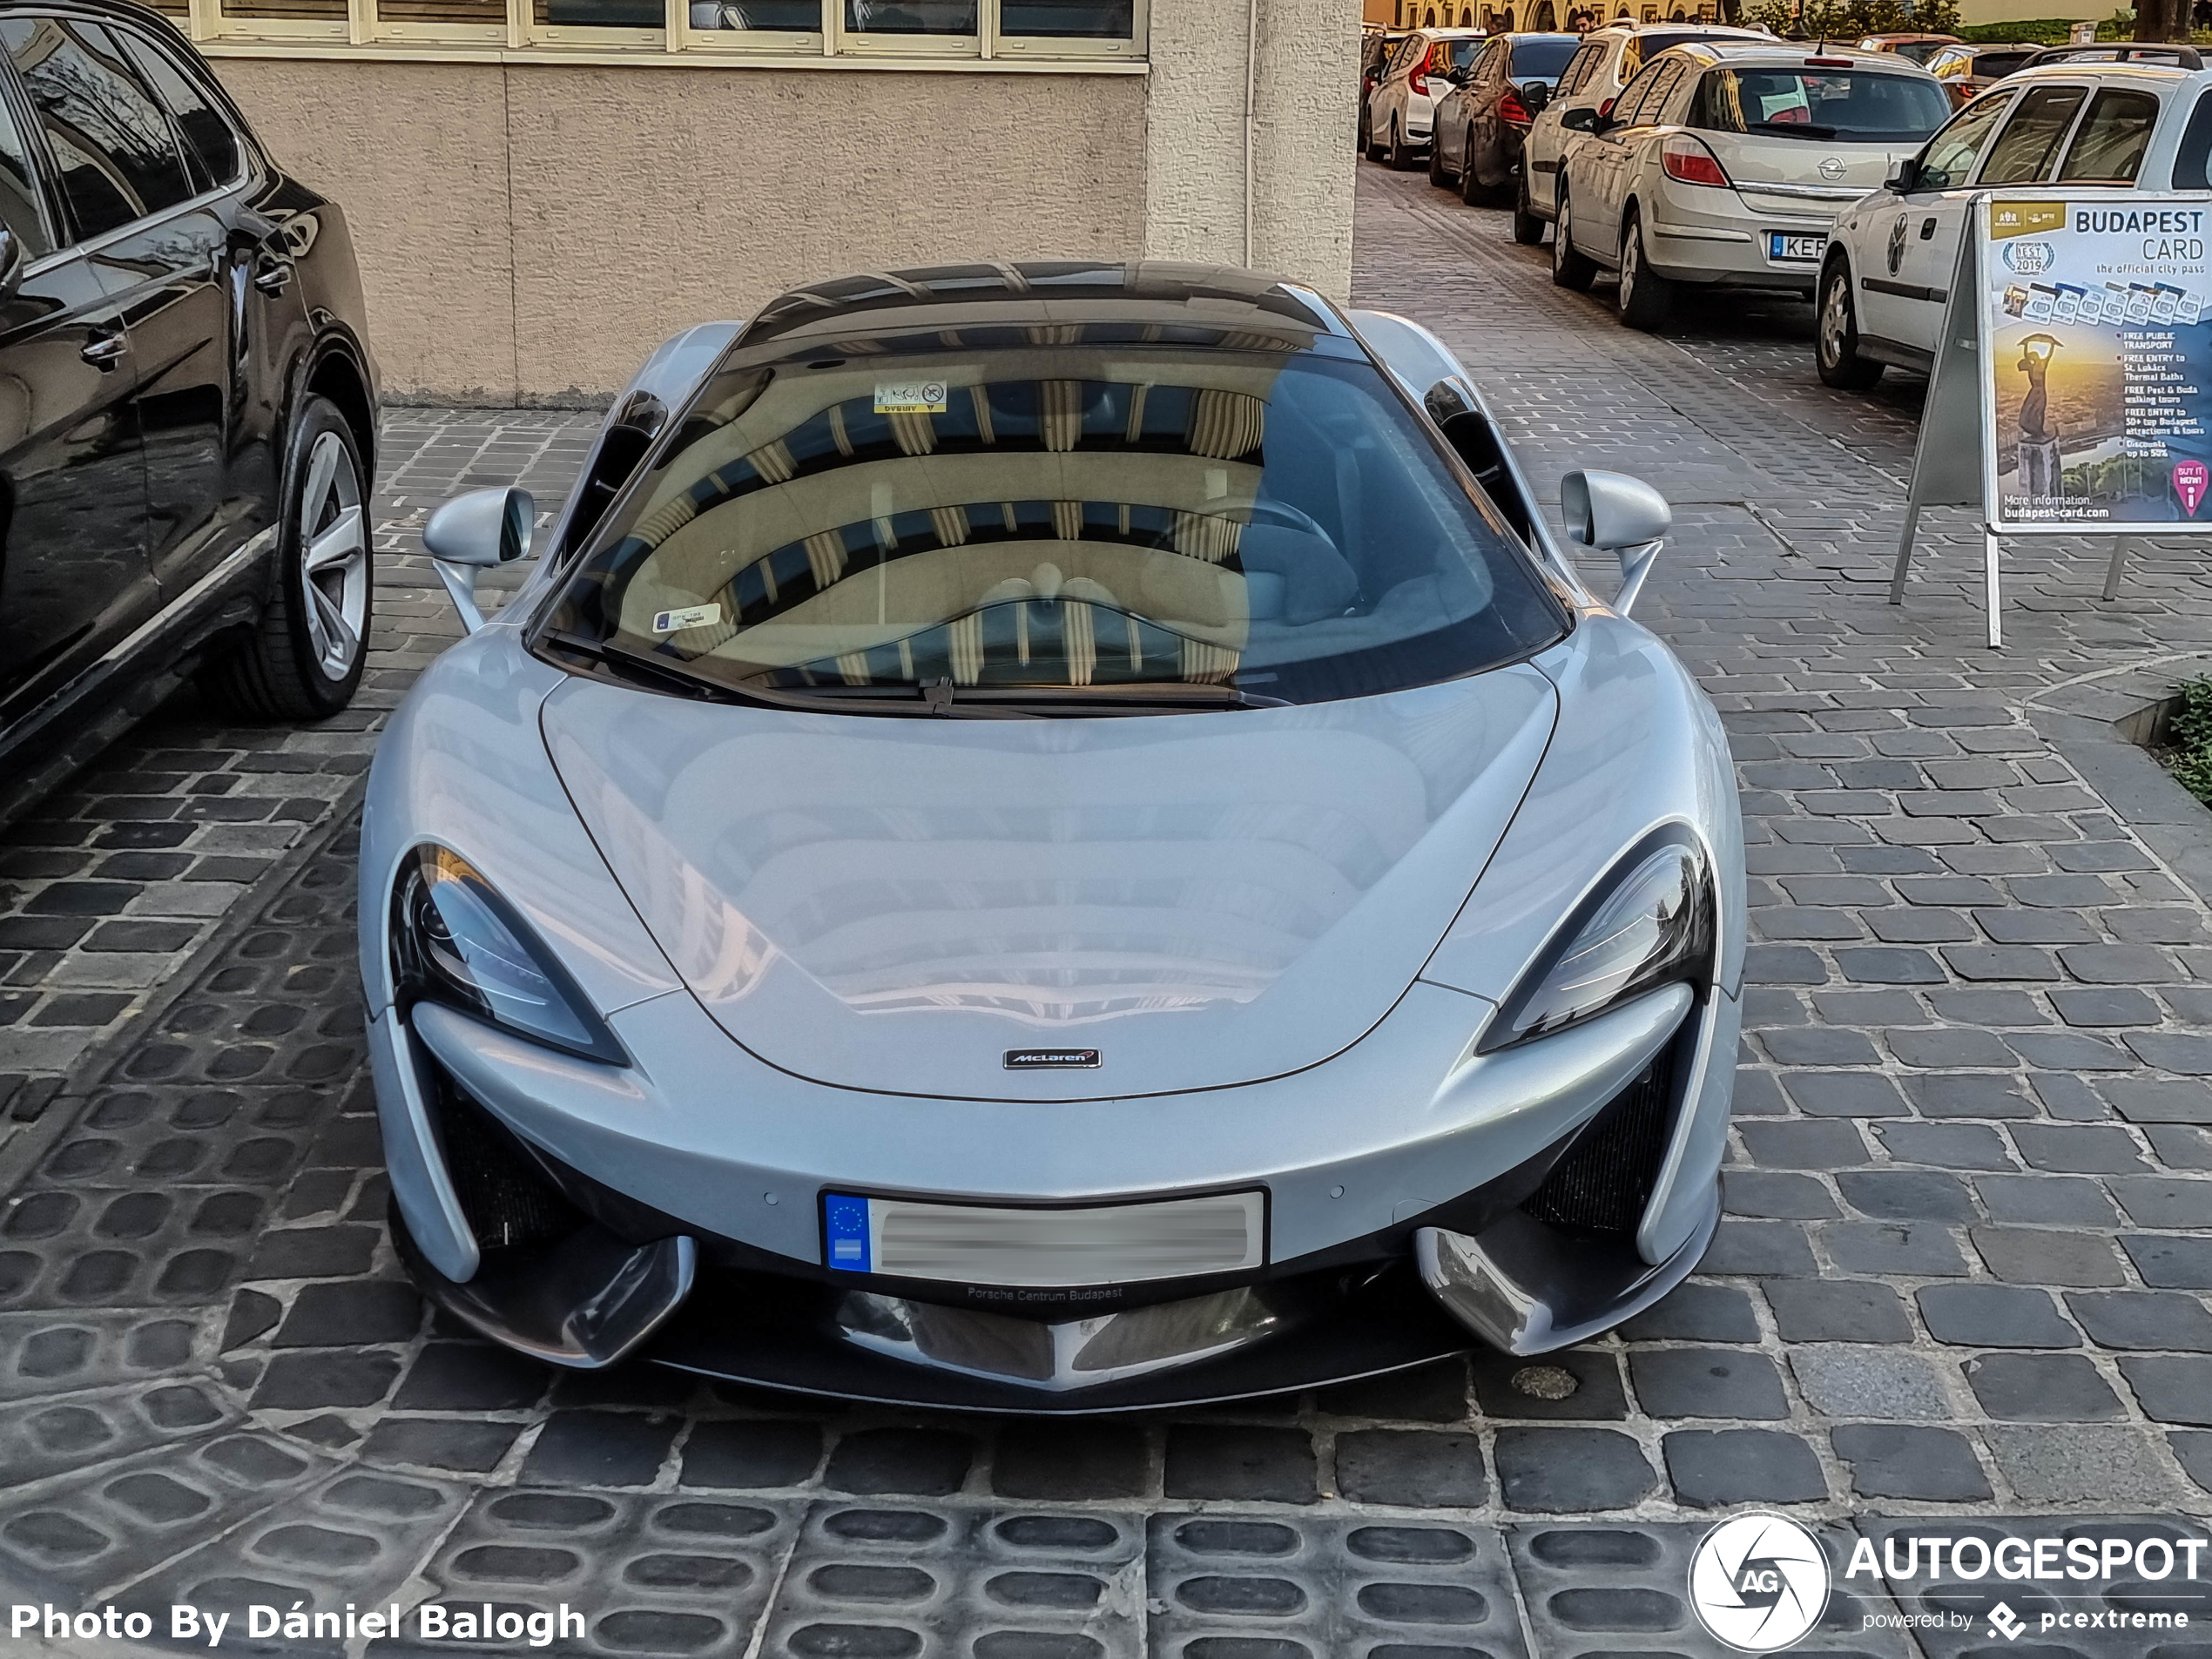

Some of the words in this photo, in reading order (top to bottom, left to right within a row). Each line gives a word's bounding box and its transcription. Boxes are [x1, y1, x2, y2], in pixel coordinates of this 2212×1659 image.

[2076, 212, 2203, 233] BUDAPEST
[2143, 239, 2203, 260] CARD
[2017, 260, 2042, 270] 2019
[2096, 265, 2113, 273] the
[2117, 265, 2154, 273] official
[2158, 265, 2177, 276] city
[2182, 266, 2205, 274] pass
[2004, 495, 2029, 505] More
[2005, 507, 2109, 520] budapest-card.com
[968, 1287, 1014, 1300] Porsche
[1017, 1291, 1066, 1301] Centrum
[1069, 1288, 1123, 1300] Budapest
